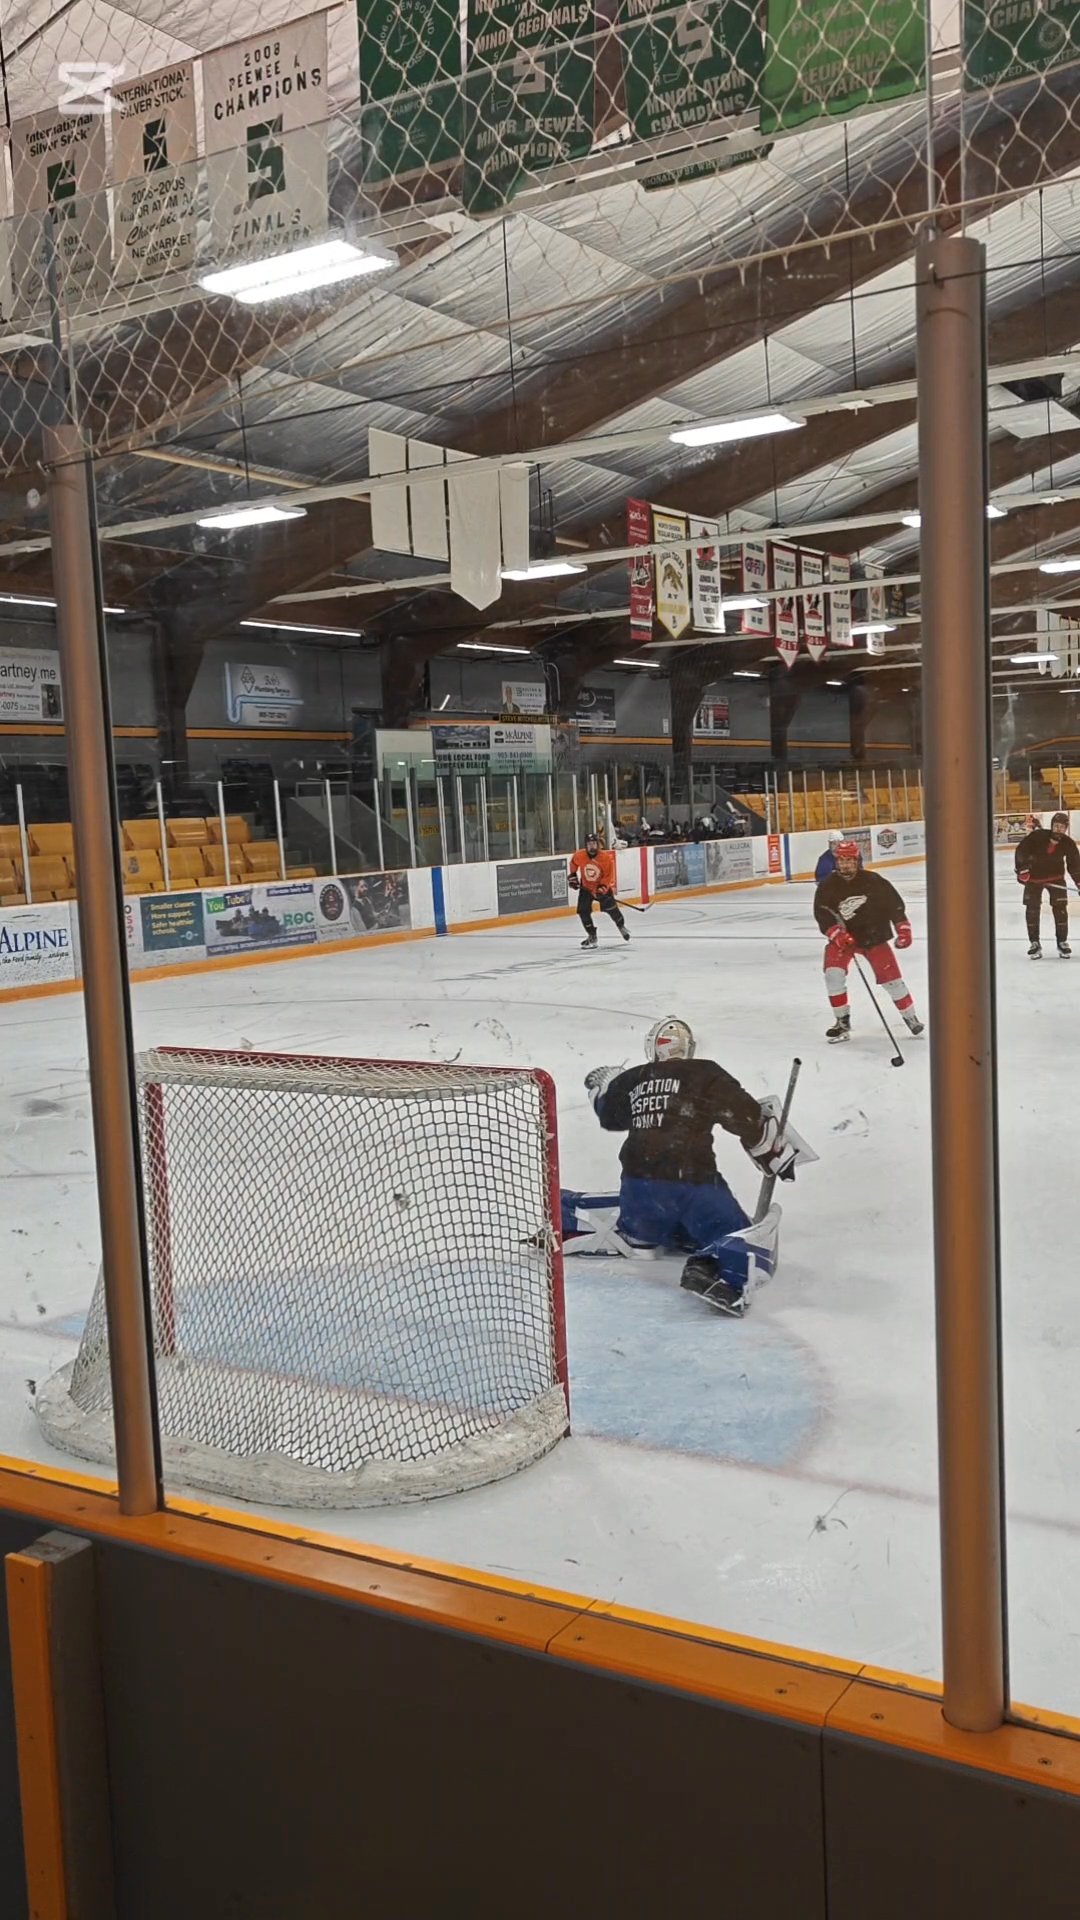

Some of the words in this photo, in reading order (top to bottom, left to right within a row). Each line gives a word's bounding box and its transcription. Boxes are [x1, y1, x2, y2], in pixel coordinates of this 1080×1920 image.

[244, 42, 281, 67] 2008
[214, 68, 322, 120] CHAMPIONS
[702, 69, 747, 98] ATOM
[389, 96, 434, 117] HAMPIOS
[650, 93, 746, 133] CHAMPIONS
[231, 207, 302, 242] FINALS
[0, 926, 69, 953] ALPINE
